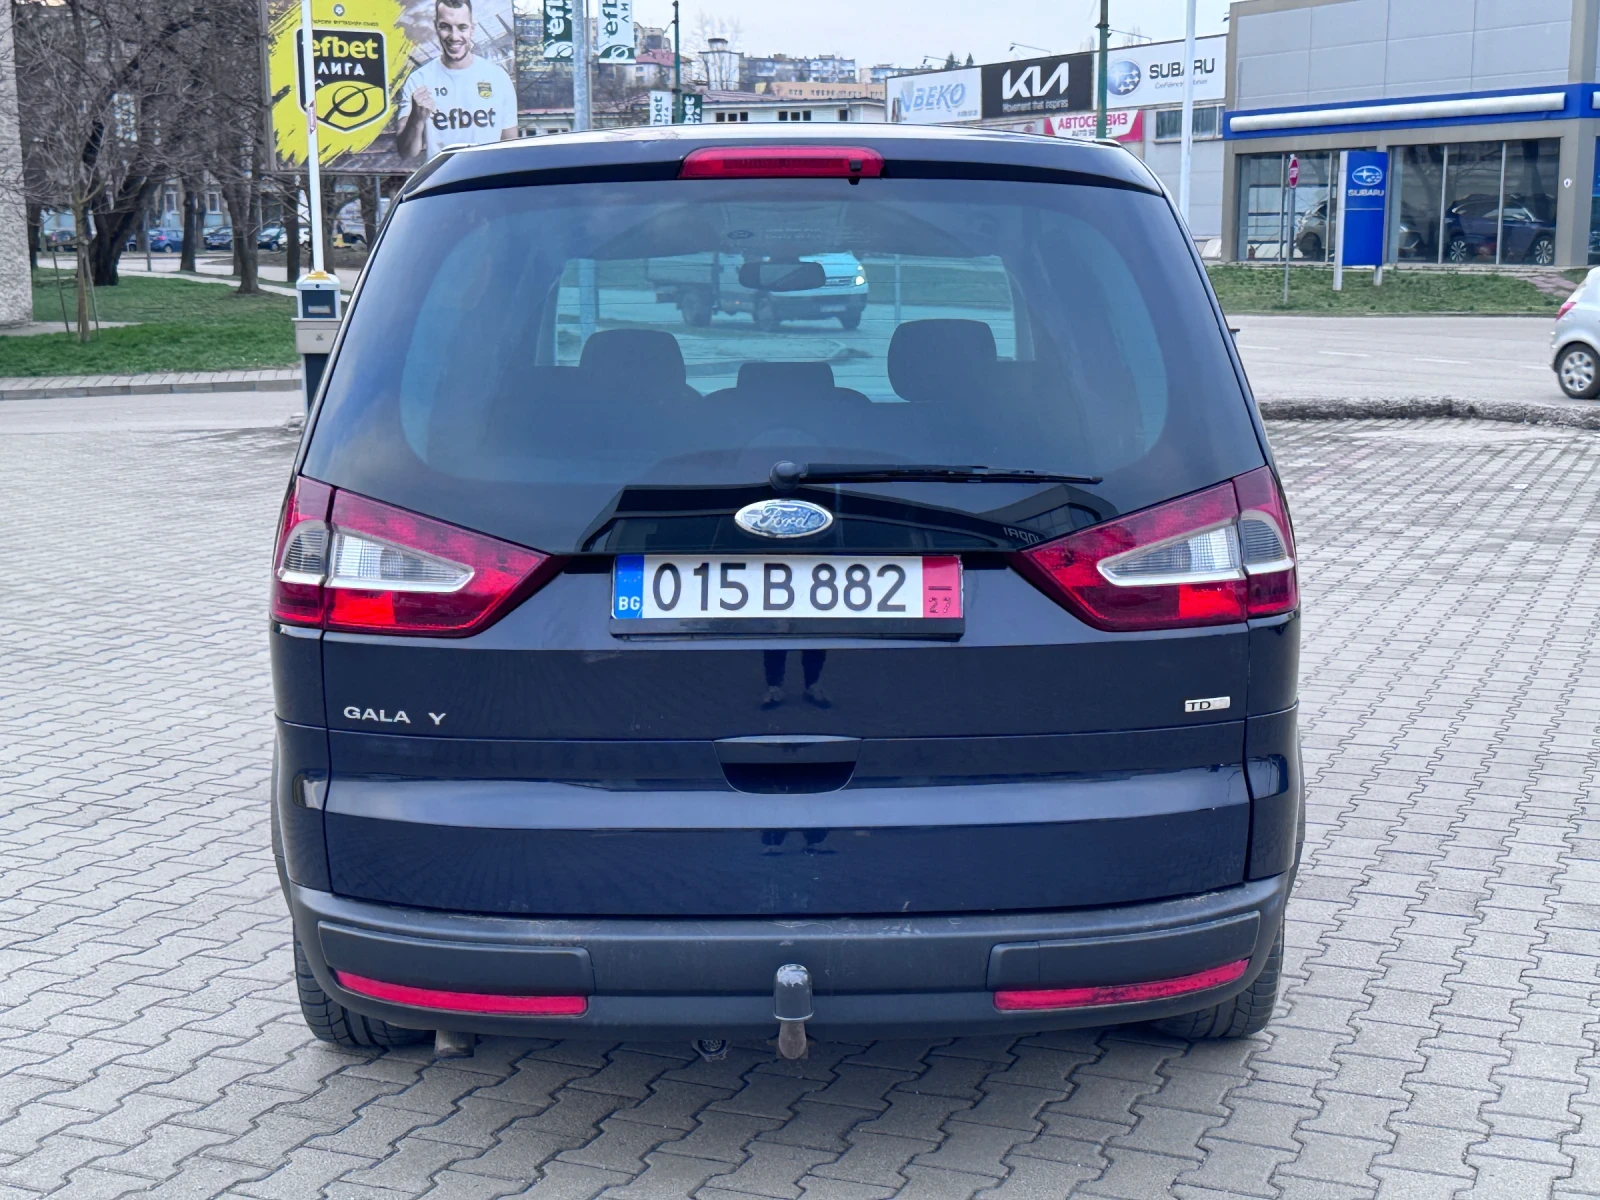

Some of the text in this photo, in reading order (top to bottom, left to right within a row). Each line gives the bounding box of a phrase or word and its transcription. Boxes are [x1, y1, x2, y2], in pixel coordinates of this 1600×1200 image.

[317, 61, 366, 76] ЛИГА
[1002, 62, 1069, 100] KIA
[434, 86, 449, 97] 10
[432, 108, 496, 130] efbet
[1057, 112, 1129, 131] АВТОСЕВИЗ
[1347, 188, 1385, 197] SUBARU
[757, 505, 812, 528] Ford
[618, 595, 642, 611] BG
[928, 596, 952, 614] 27
